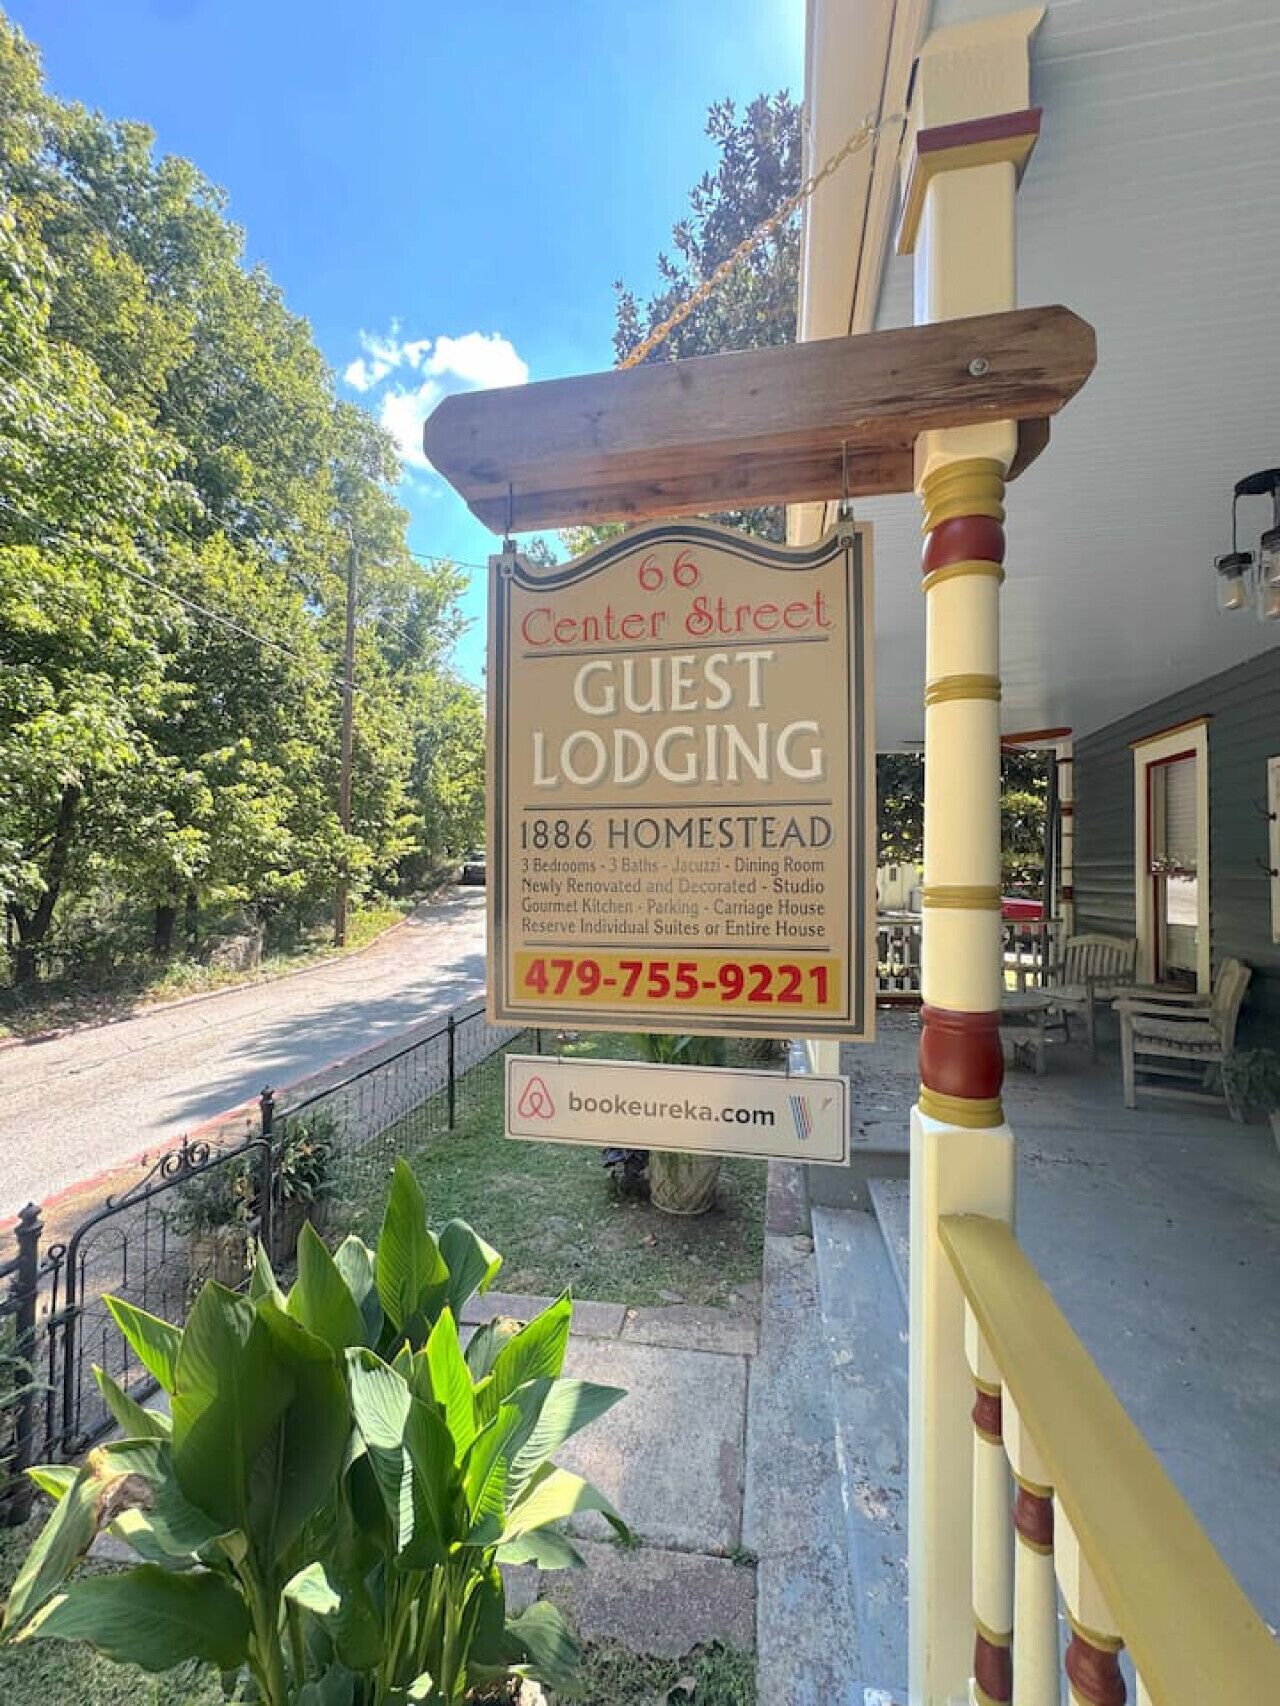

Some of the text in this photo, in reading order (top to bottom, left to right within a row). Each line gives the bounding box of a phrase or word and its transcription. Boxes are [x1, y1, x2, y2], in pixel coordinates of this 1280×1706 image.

[638, 550, 699, 591] 66
[521, 590, 834, 646] Center Street
[573, 651, 774, 716] GUEST
[532, 720, 823, 785] LODGING
[521, 816, 832, 849] 1886 HOMESTEAD
[521, 858, 529, 873] 3
[533, 857, 596, 873] Bedrooms
[609, 858, 618, 873] 3
[622, 857, 657, 873] Baths
[671, 857, 720, 873] Jacuzzi
[734, 856, 779, 876] Dining
[783, 856, 825, 872] Room
[521, 878, 562, 896] Newly
[567, 877, 641, 893] Renovated
[648, 878, 673, 893] and
[679, 878, 756, 893] Decorated
[772, 877, 825, 894] Studio
[521, 897, 578, 913] Gourmet
[582, 898, 634, 913] Kitchen
[647, 899, 698, 918] Parking
[713, 899, 773, 919] Carriage
[778, 900, 826, 916] House
[522, 917, 826, 937] Reserve Individual Suites or Entire House
[524, 957, 829, 1005] 479-755-9221
[568, 1091, 776, 1127] bookeureka.com
